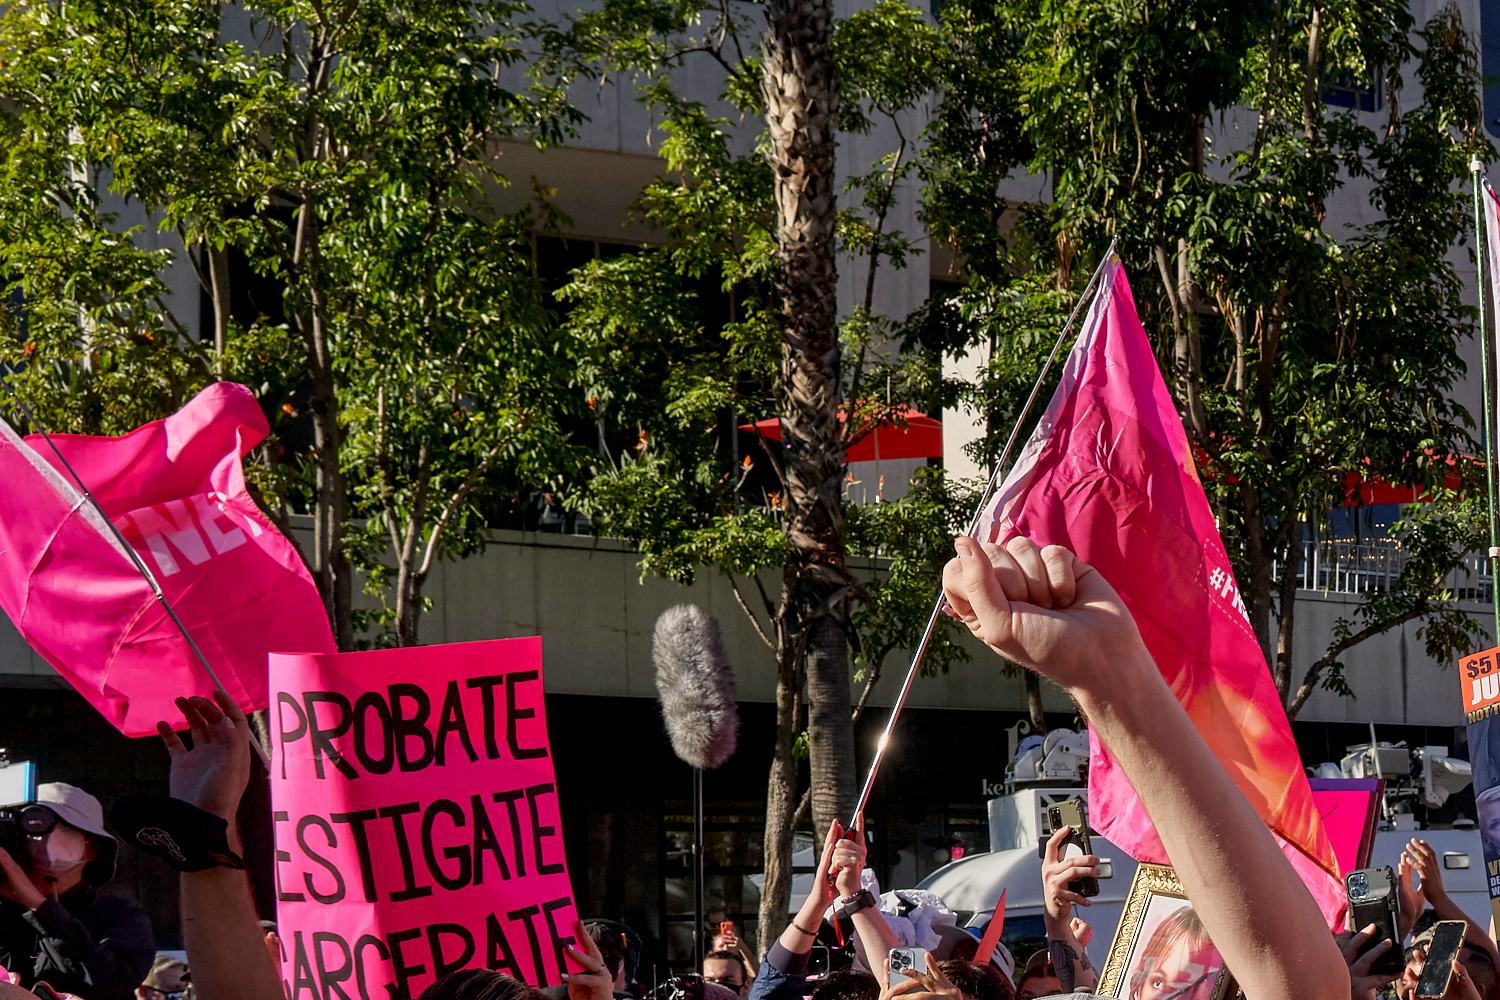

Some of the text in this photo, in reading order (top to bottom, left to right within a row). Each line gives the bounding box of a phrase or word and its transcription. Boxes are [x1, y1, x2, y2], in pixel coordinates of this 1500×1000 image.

[1467, 657, 1492, 679] $5
[277, 669, 548, 780] PROBATE
[1467, 704, 1492, 724] NOT
[274, 782, 565, 905] ESTIGATE
